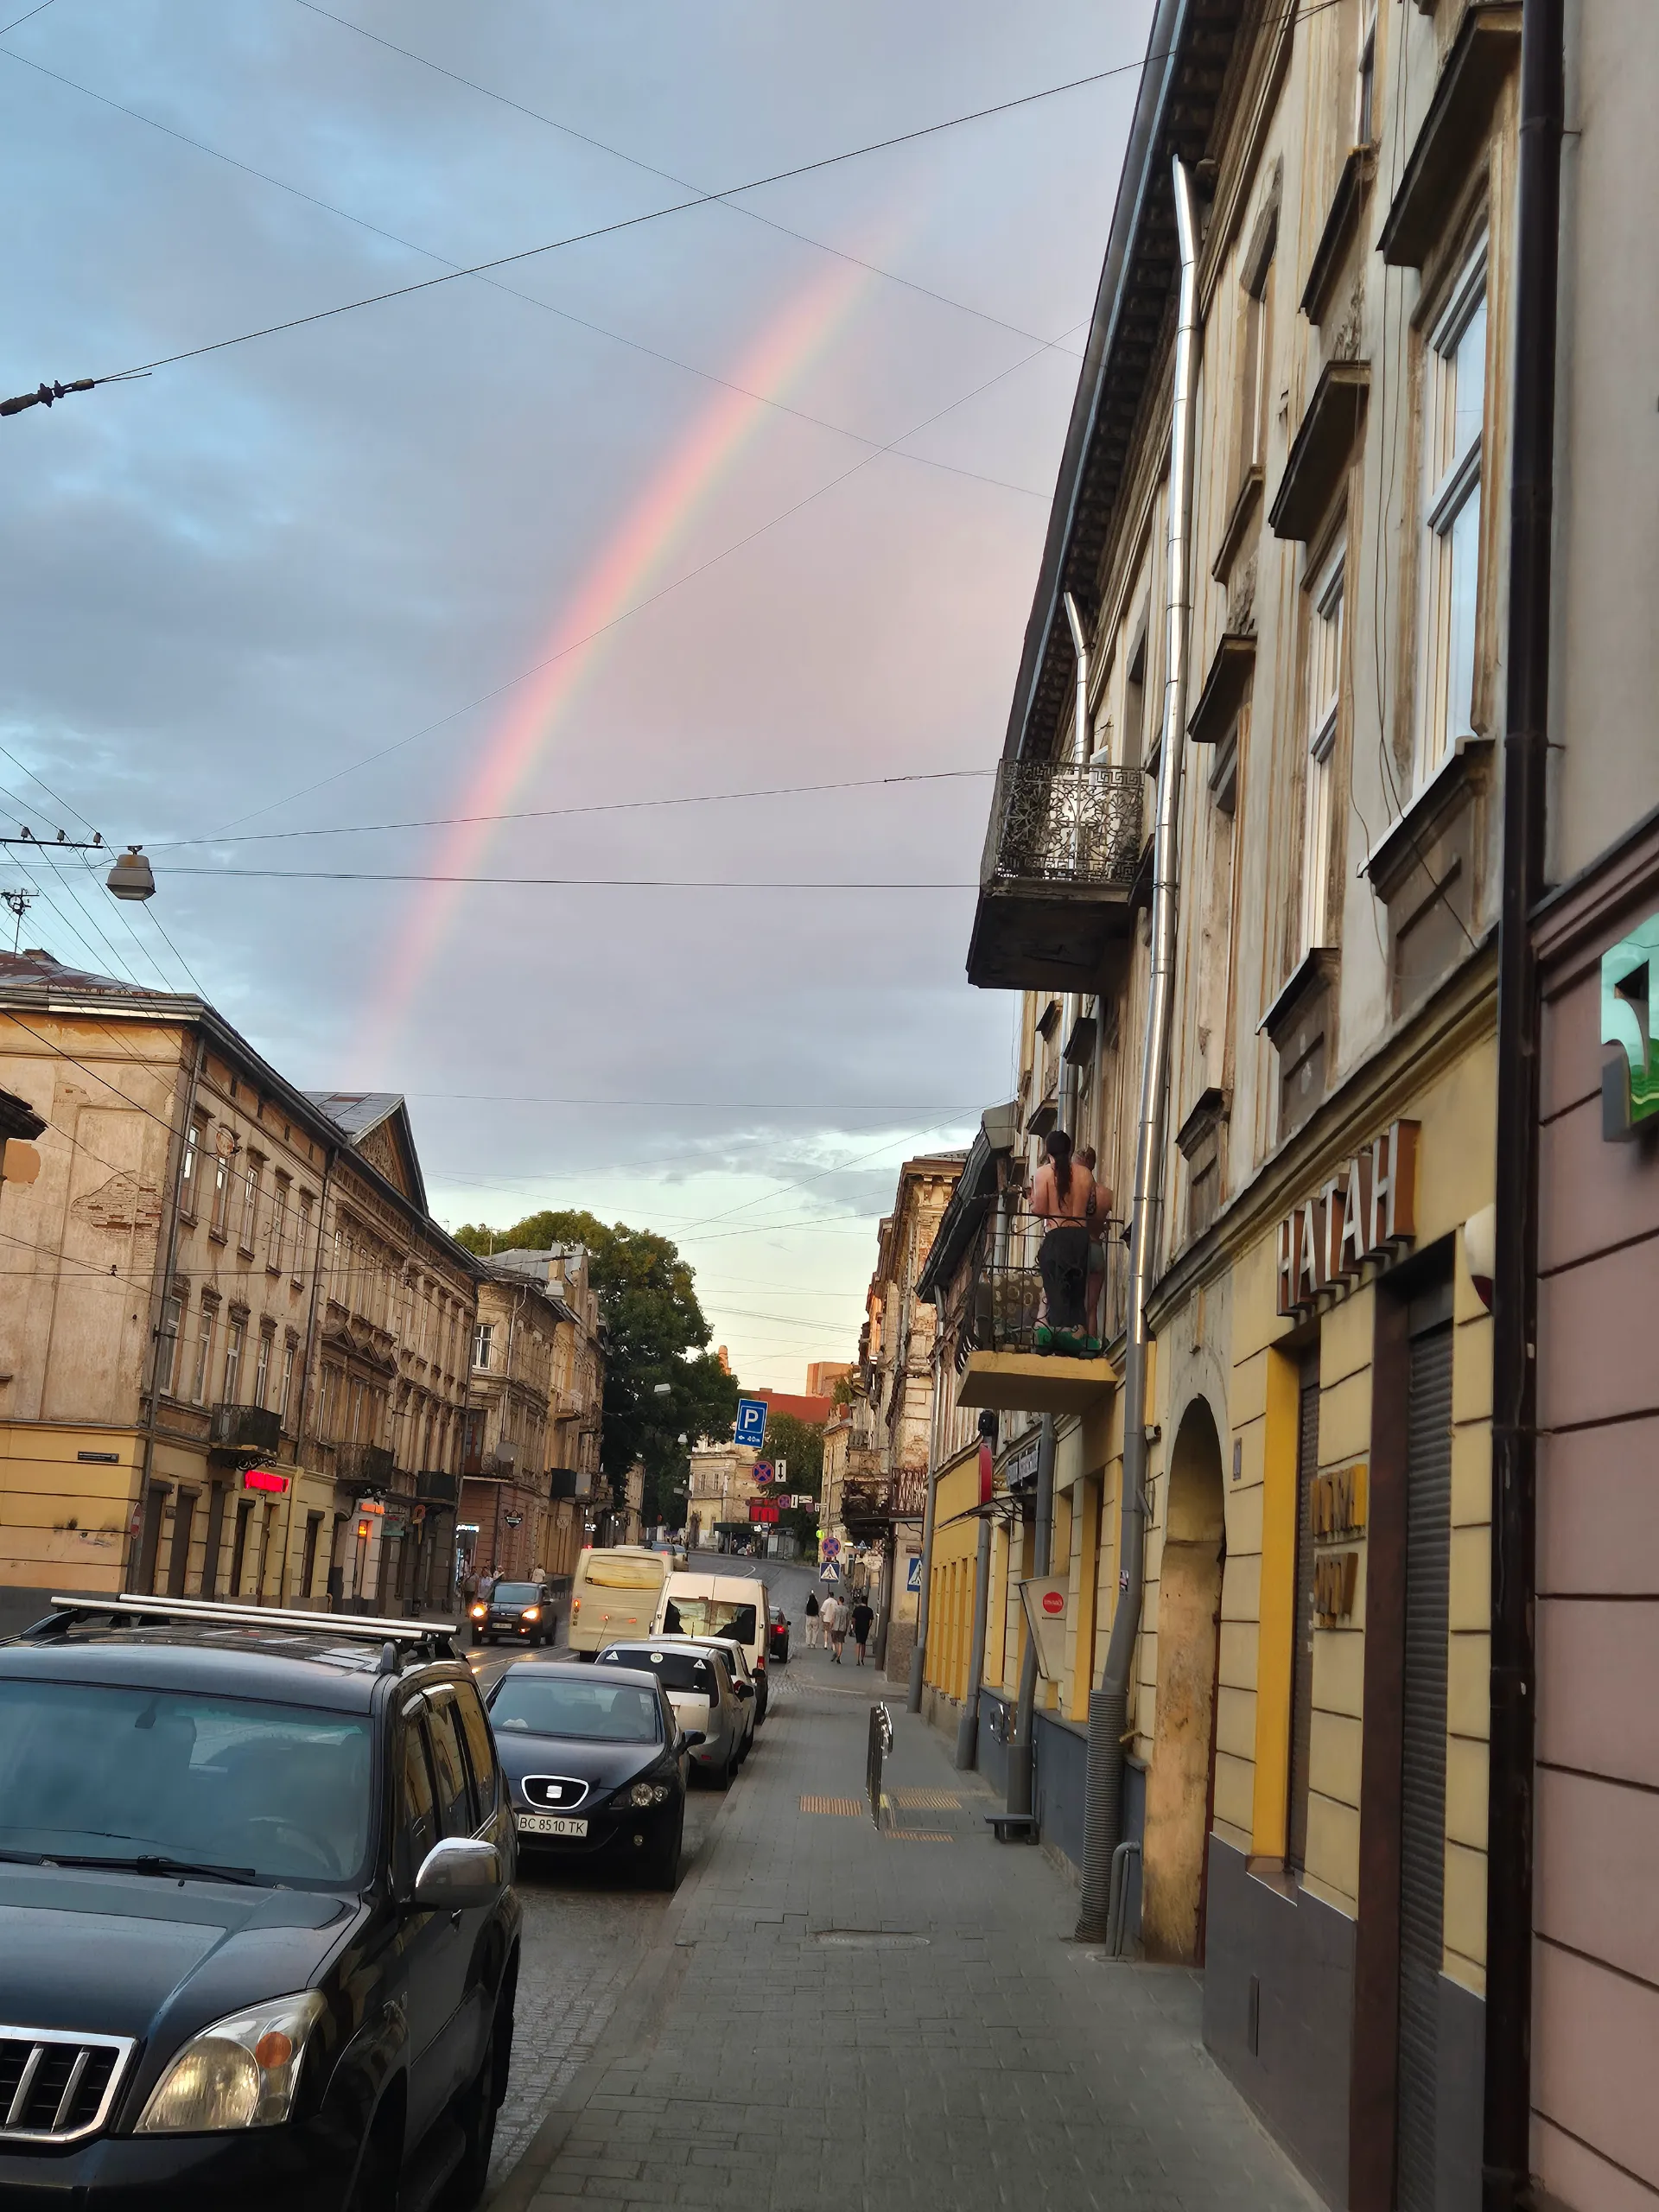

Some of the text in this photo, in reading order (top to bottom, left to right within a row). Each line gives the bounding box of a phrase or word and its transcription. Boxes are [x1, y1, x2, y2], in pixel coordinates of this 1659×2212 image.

[1277, 1119, 1410, 1315] НАТАН
[744, 1408, 759, 1429] P
[519, 1817, 585, 1834] BC 8510 TK
